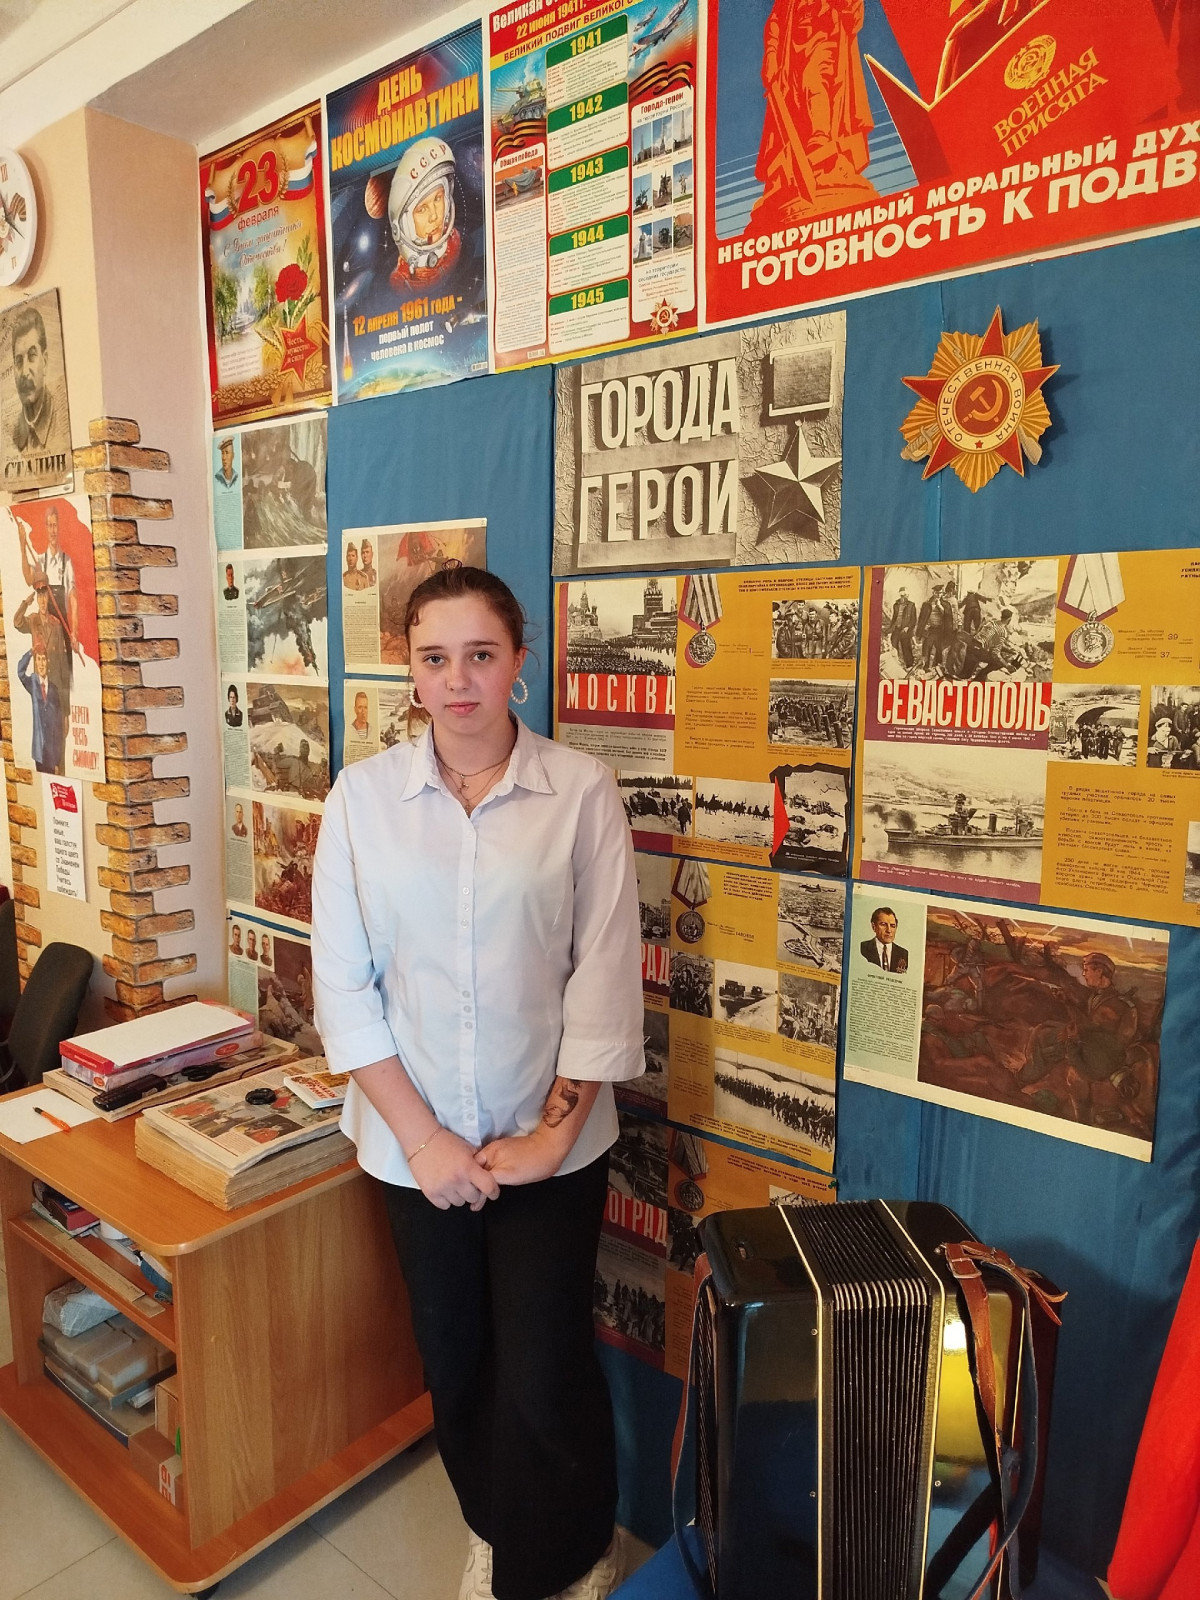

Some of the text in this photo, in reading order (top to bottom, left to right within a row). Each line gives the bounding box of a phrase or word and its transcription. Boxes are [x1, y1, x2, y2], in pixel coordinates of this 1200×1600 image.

[504, 36, 543, 62] ВЕЛИКИЙ
[545, 18, 581, 42] ПОДВИГ
[516, 23, 528, 40] 22
[529, 13, 555, 34] июня
[569, 28, 602, 56] 1941
[377, 65, 423, 115] ДЕНЬ
[569, 95, 603, 122] 1942
[640, 92, 684, 114] Города-герои
[992, 46, 1100, 142] ВОЕННАЯ
[330, 73, 480, 172] КОСМОНАВТИКИ
[1001, 72, 1109, 158] ПРИСЯГА
[237, 150, 279, 215] 23
[409, 144, 447, 180] СССР
[570, 157, 603, 183] 1943
[717, 119, 1200, 264] НЕСОКРУШИМЫЙ МОРАЛЬНЫЙ ДУХ
[237, 205, 279, 231] февраля
[571, 224, 605, 249] 1944
[740, 149, 1200, 290] ГОТОВНОСТЬ К ПОДВ
[352, 314, 366, 337] 12
[400, 296, 429, 323] 1961
[570, 287, 605, 310] 1945
[370, 345, 407, 362] человека
[413, 334, 445, 352] космос
[378, 320, 434, 345] первый полет
[581, 357, 740, 452] ГОРОДА
[940, 360, 1018, 443] ОТЕЧЕСТВЕННАЯ
[4, 453, 66, 479] СТАЛИН
[579, 459, 738, 544] ГЕРОИ
[1160, 651, 1171, 659] 37
[566, 673, 676, 715] МОСКВА
[877, 679, 1051, 732] СЕВАСТОПОЛЬ
[608, 1190, 667, 1248] ОГРАД
